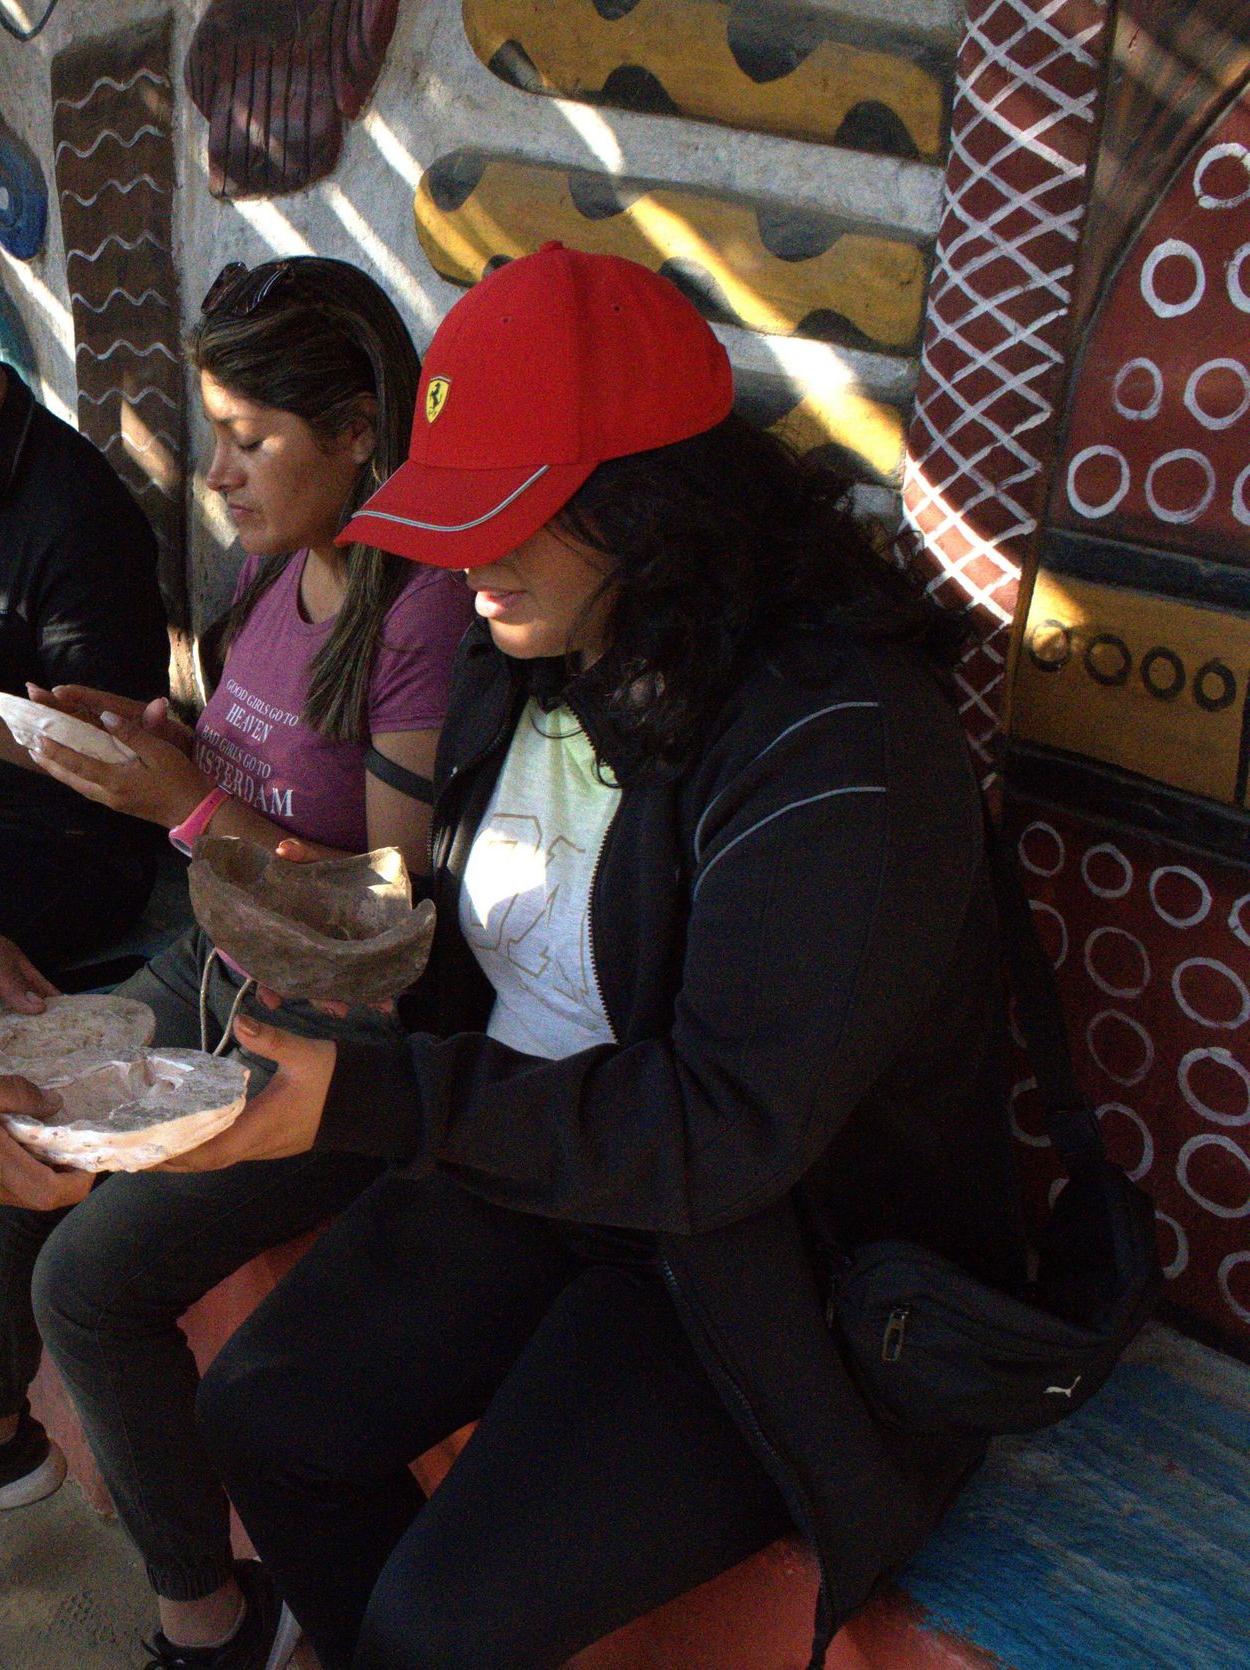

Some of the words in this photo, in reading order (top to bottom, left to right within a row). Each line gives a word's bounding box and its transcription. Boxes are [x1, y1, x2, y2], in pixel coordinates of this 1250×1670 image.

[225, 703, 273, 743] HEAVEN
[226, 679, 248, 701] GOOD
[246, 694, 269, 715] GIRLS
[269, 707, 283, 720] GO
[283, 712, 299, 727] TO
[202, 724, 220, 746] BAD
[219, 738, 243, 762] GIRLS
[243, 753, 256, 771] GO
[257, 761, 271, 779] TO
